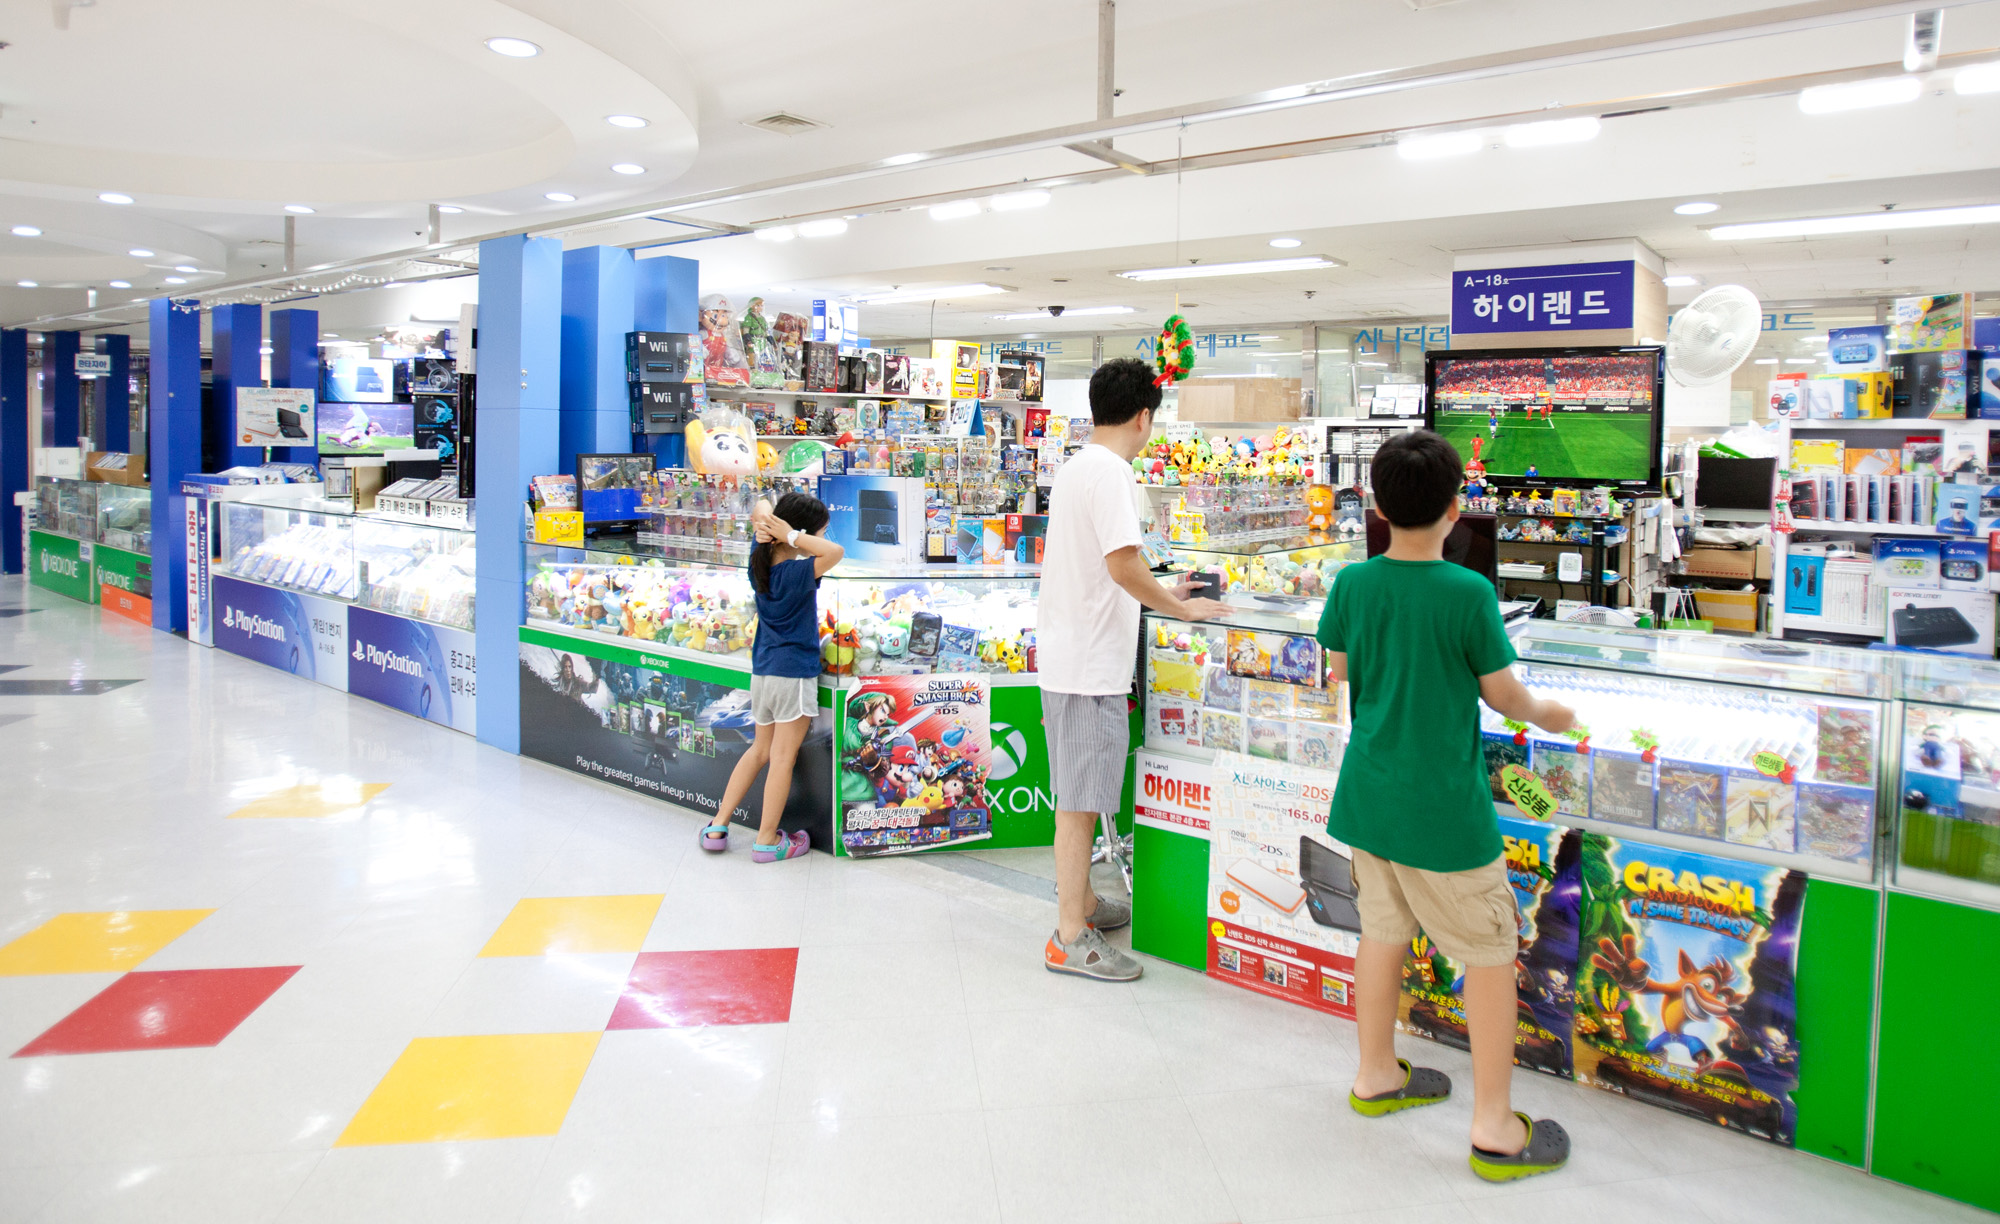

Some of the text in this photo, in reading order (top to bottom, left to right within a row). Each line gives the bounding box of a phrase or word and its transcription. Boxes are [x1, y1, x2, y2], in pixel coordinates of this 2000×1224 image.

[1464, 274, 1509, 288] A-18호
[1472, 290, 1610, 325] 하이랜드
[649, 341, 669, 353] Wii
[653, 392, 672, 404] Wii
[1562, 404, 1586, 412] Joywave
[200, 531, 208, 601] PlayStation
[235, 609, 286, 642] PlayStation
[312, 618, 342, 639] 게임1번지
[366, 644, 423, 678] PlayStation
[451, 650, 463, 668] 중고
[451, 676, 464, 696] 판매
[928, 680, 962, 691] SUPER
[914, 692, 949, 706] SMASH
[934, 708, 959, 716] 3DS
[1145, 760, 1168, 772] Hi Land
[1512, 764, 1536, 782] NEW
[576, 756, 590, 771] Play
[591, 760, 602, 773] the
[604, 766, 633, 783] greatest
[634, 776, 660, 791] games
[660, 782, 685, 800] lineup
[686, 790, 694, 802] in
[696, 792, 716, 809] Xbox
[1232, 771, 1250, 786] XL
[1254, 775, 1298, 796] 사이즈의
[1507, 777, 1551, 818] 신상품
[848, 806, 926, 818] 올스타 게임 캐릭터들이
[1144, 808, 1168, 820] 전자랜드
[1170, 814, 1182, 824] 본관
[847, 818, 870, 830] 펼치는
[872, 818, 886, 828] 꿈의
[1260, 844, 1283, 856] 2DS
[1624, 861, 1756, 916] CRASH
[1649, 889, 1733, 916] BANDICOOT
[1689, 906, 1754, 936] TRILOGY
[1228, 929, 1244, 940] 닌텐도
[1244, 934, 1256, 942] 3DS
[1257, 938, 1268, 948] 신작
[1269, 942, 1298, 956] 소프트웨어
[1410, 988, 1464, 1013] 더욱 새로워진
[1438, 1010, 1466, 1026] N-진에
[1407, 1025, 1434, 1038] PS4
[1518, 1020, 1556, 1042] 시와 함께
[1600, 1044, 1772, 1104] 더욱 새로워진 모습의 크래시와 함께
[1594, 1079, 1624, 1094] PS4
[1631, 1064, 1736, 1105] N-진에 시동을 거세요!
